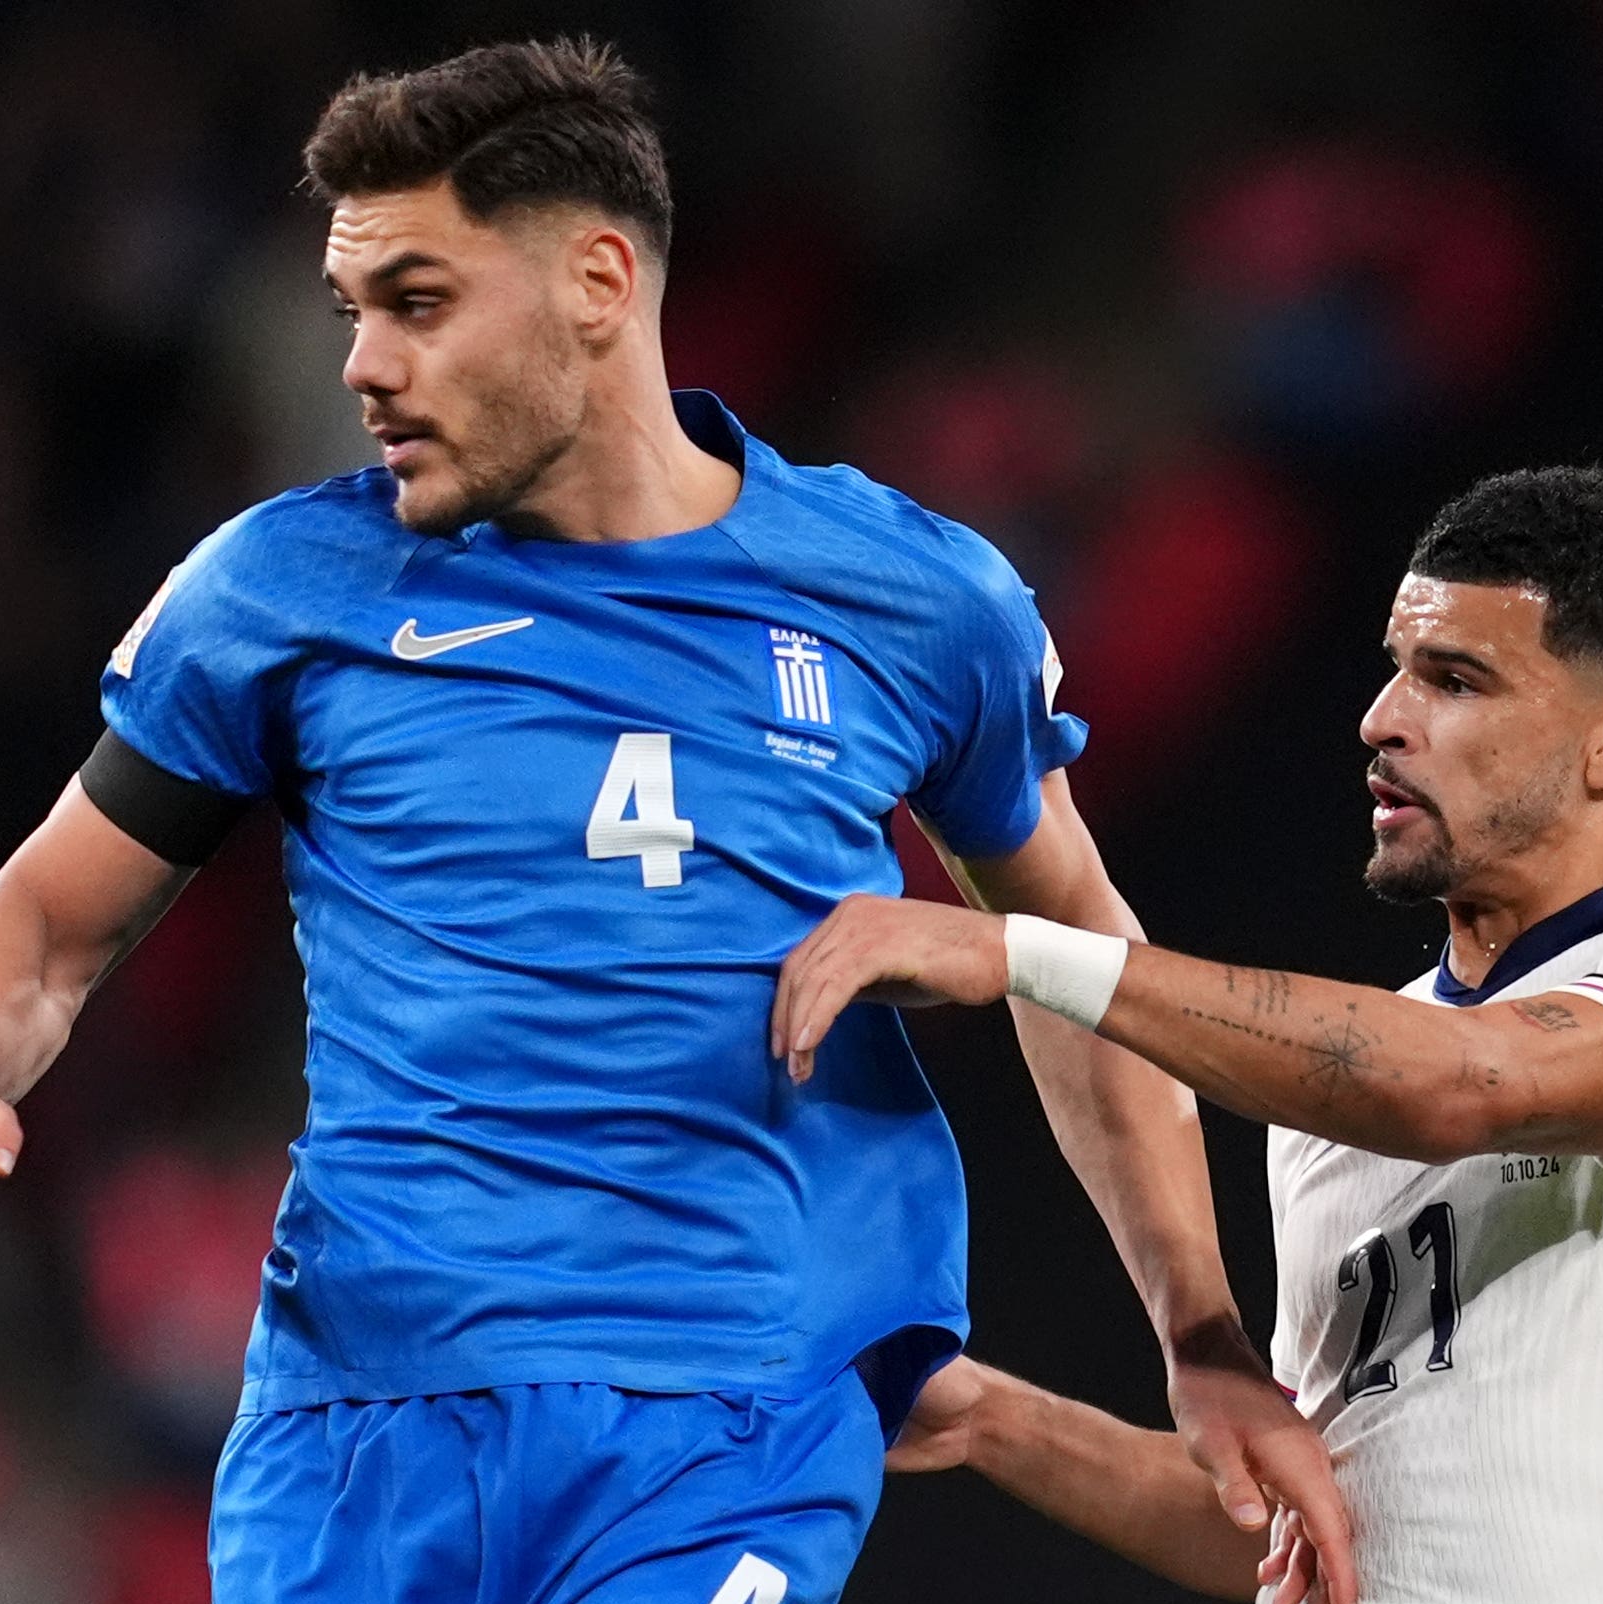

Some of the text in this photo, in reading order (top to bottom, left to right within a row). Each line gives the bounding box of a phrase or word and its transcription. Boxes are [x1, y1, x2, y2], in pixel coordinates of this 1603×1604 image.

[586, 733, 694, 888] 4
[1500, 1156, 1560, 1184] 10.10.24
[1339, 1201, 1461, 1404] 21
